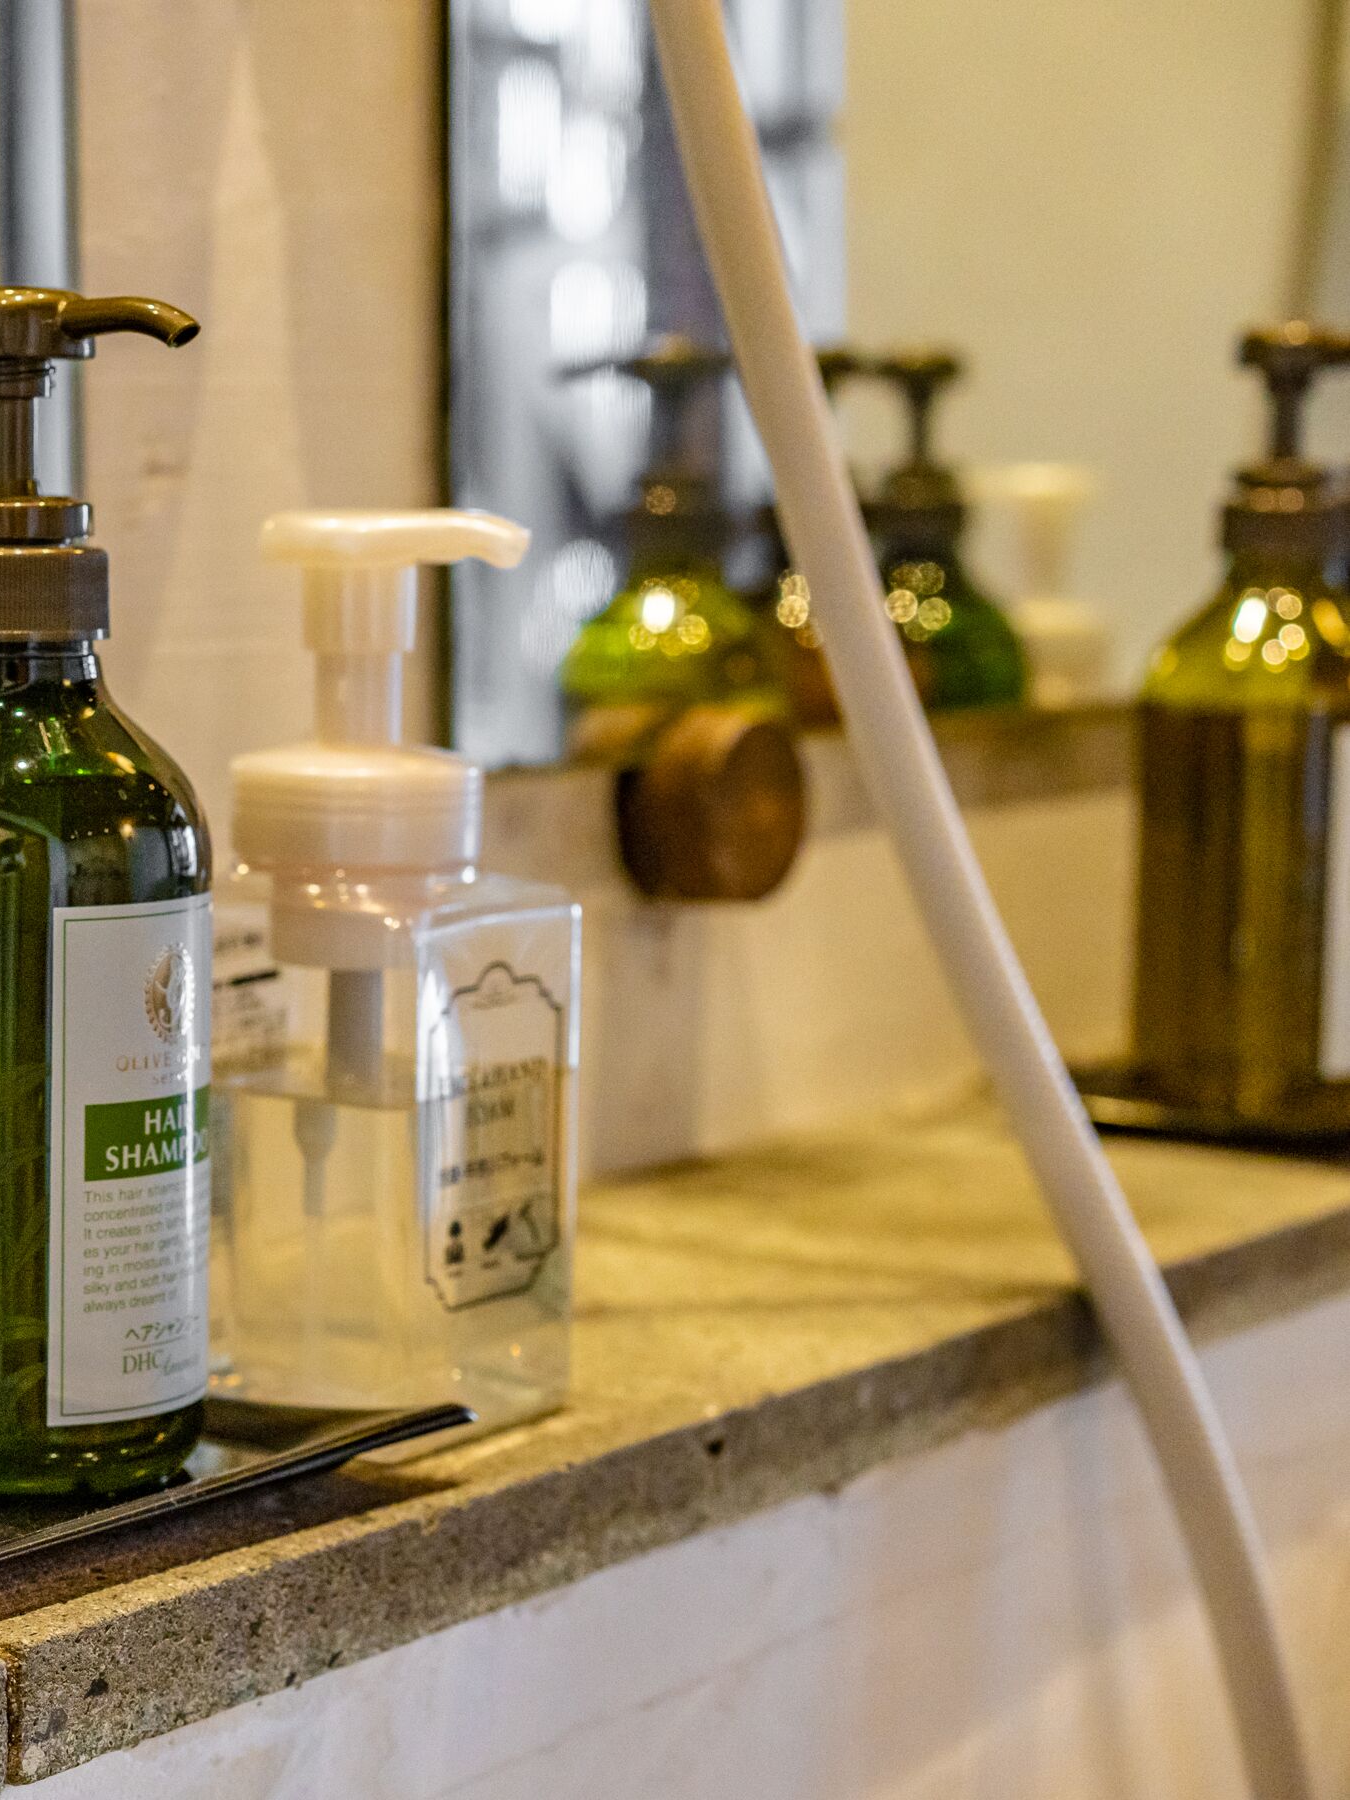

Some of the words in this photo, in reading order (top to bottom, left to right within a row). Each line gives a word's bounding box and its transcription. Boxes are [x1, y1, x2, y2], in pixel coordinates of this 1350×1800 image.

[115, 1051, 170, 1072] OLIVE
[145, 1103, 192, 1135] HAI
[84, 1190, 113, 1203] This
[122, 1349, 163, 1374] DHC
